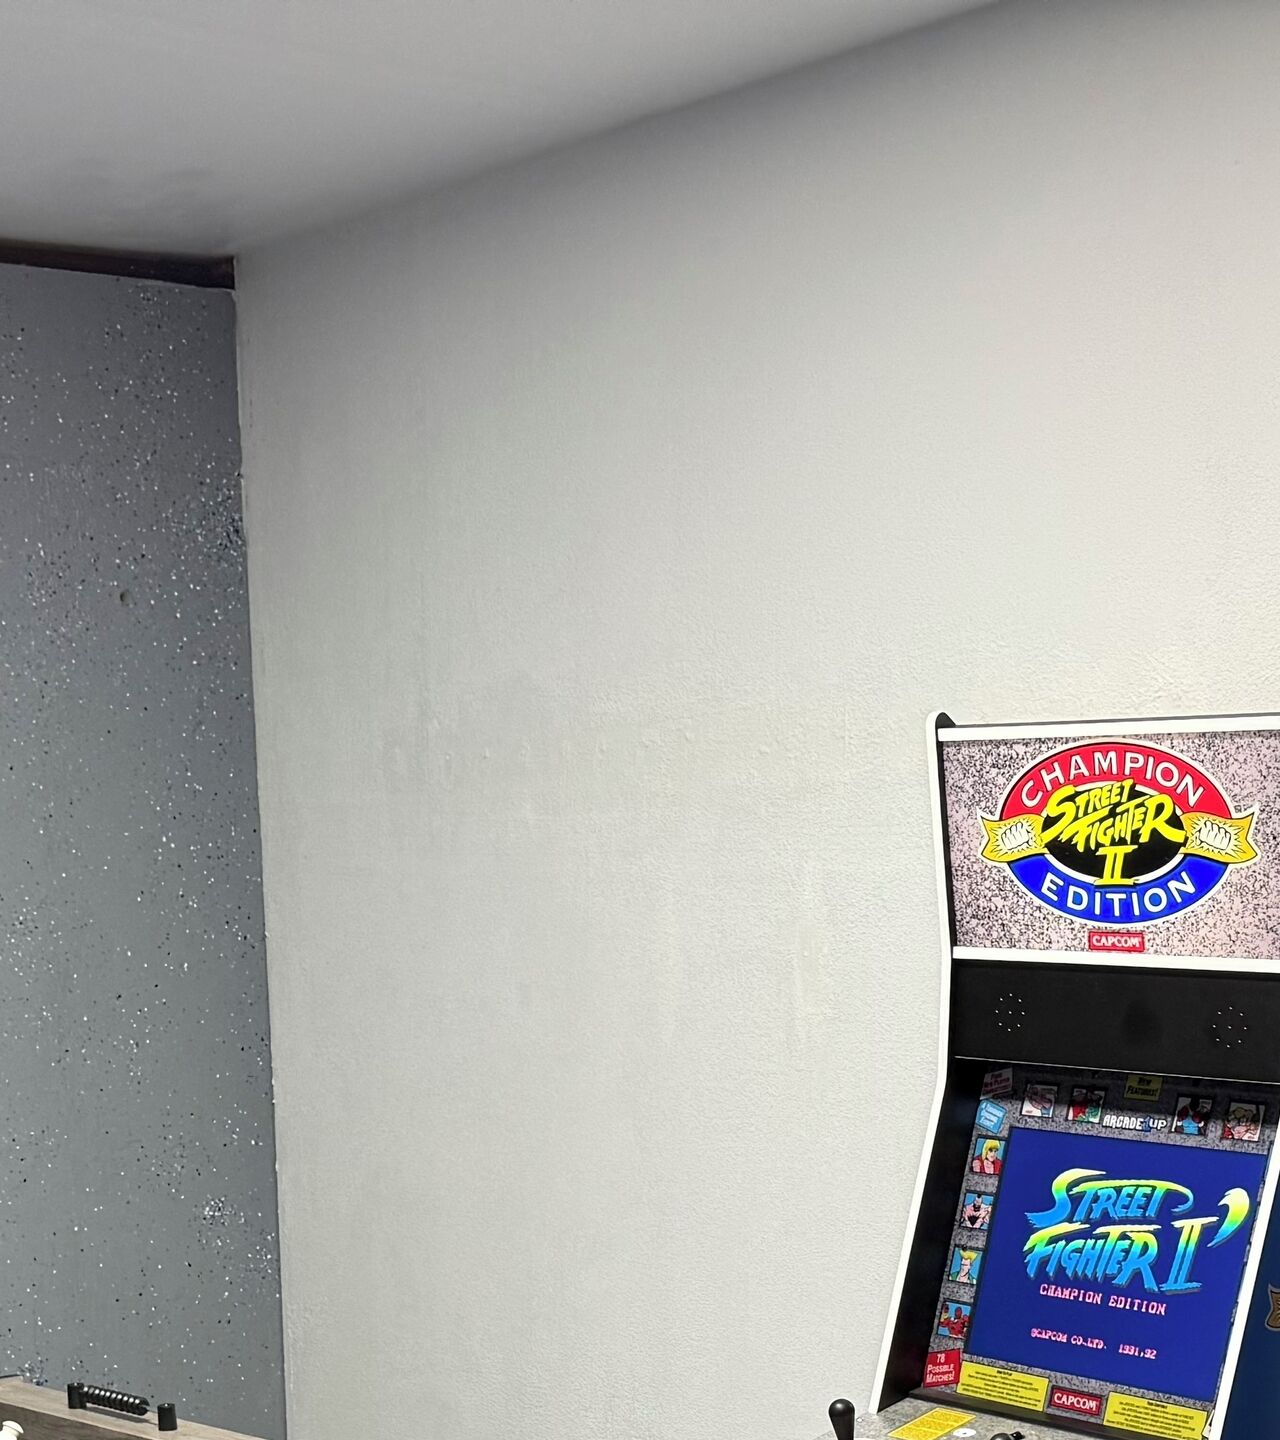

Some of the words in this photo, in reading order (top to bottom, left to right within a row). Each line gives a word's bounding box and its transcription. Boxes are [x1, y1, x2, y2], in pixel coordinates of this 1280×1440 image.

[1021, 750, 1204, 809] CHAMPION
[1040, 778, 1136, 846] STREET
[1059, 793, 1186, 853] FIGHTER
[1094, 846, 1139, 886] II
[1040, 872, 1197, 917] EDITION
[1091, 934, 1141, 949] CAPCOM
[1024, 1168, 1194, 1228] STREET
[1023, 1222, 1162, 1293] FIGHTER
[1039, 1284, 1102, 1305] CHAMPION
[1108, 1296, 1166, 1316] EDITION
[936, 1353, 946, 1362] 78
[1053, 1391, 1099, 1412] CAPCOM
